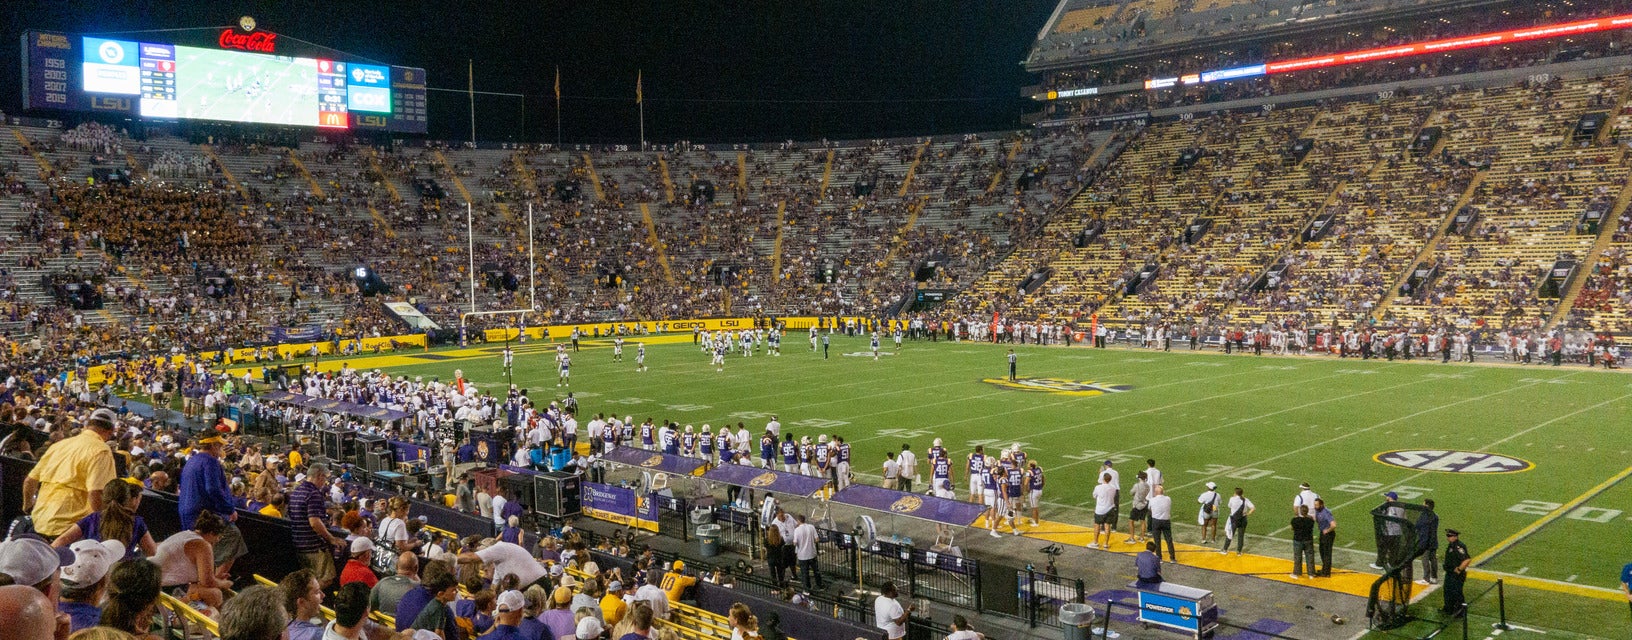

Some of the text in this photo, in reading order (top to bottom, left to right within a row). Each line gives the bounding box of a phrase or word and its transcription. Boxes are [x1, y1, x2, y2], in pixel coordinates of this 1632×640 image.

[218, 28, 276, 53] Coca-Cola
[45, 58, 65, 69] 1958
[44, 70, 66, 80] 2003
[44, 81, 66, 92] 2007
[46, 93, 66, 103] 2019
[91, 95, 131, 110] LSU
[357, 114, 386, 127] LSU
[356, 267, 366, 277] 16
[672, 321, 706, 330] GEICO
[720, 319, 740, 327] LSU
[783, 445, 794, 457] 95
[817, 448, 828, 461] 48
[970, 459, 983, 471] 38
[1384, 450, 1523, 473] SEC
[936, 464, 948, 475] 48
[1330, 480, 1433, 500] 25
[1506, 499, 1623, 523] 20
[660, 574, 676, 591] 10
